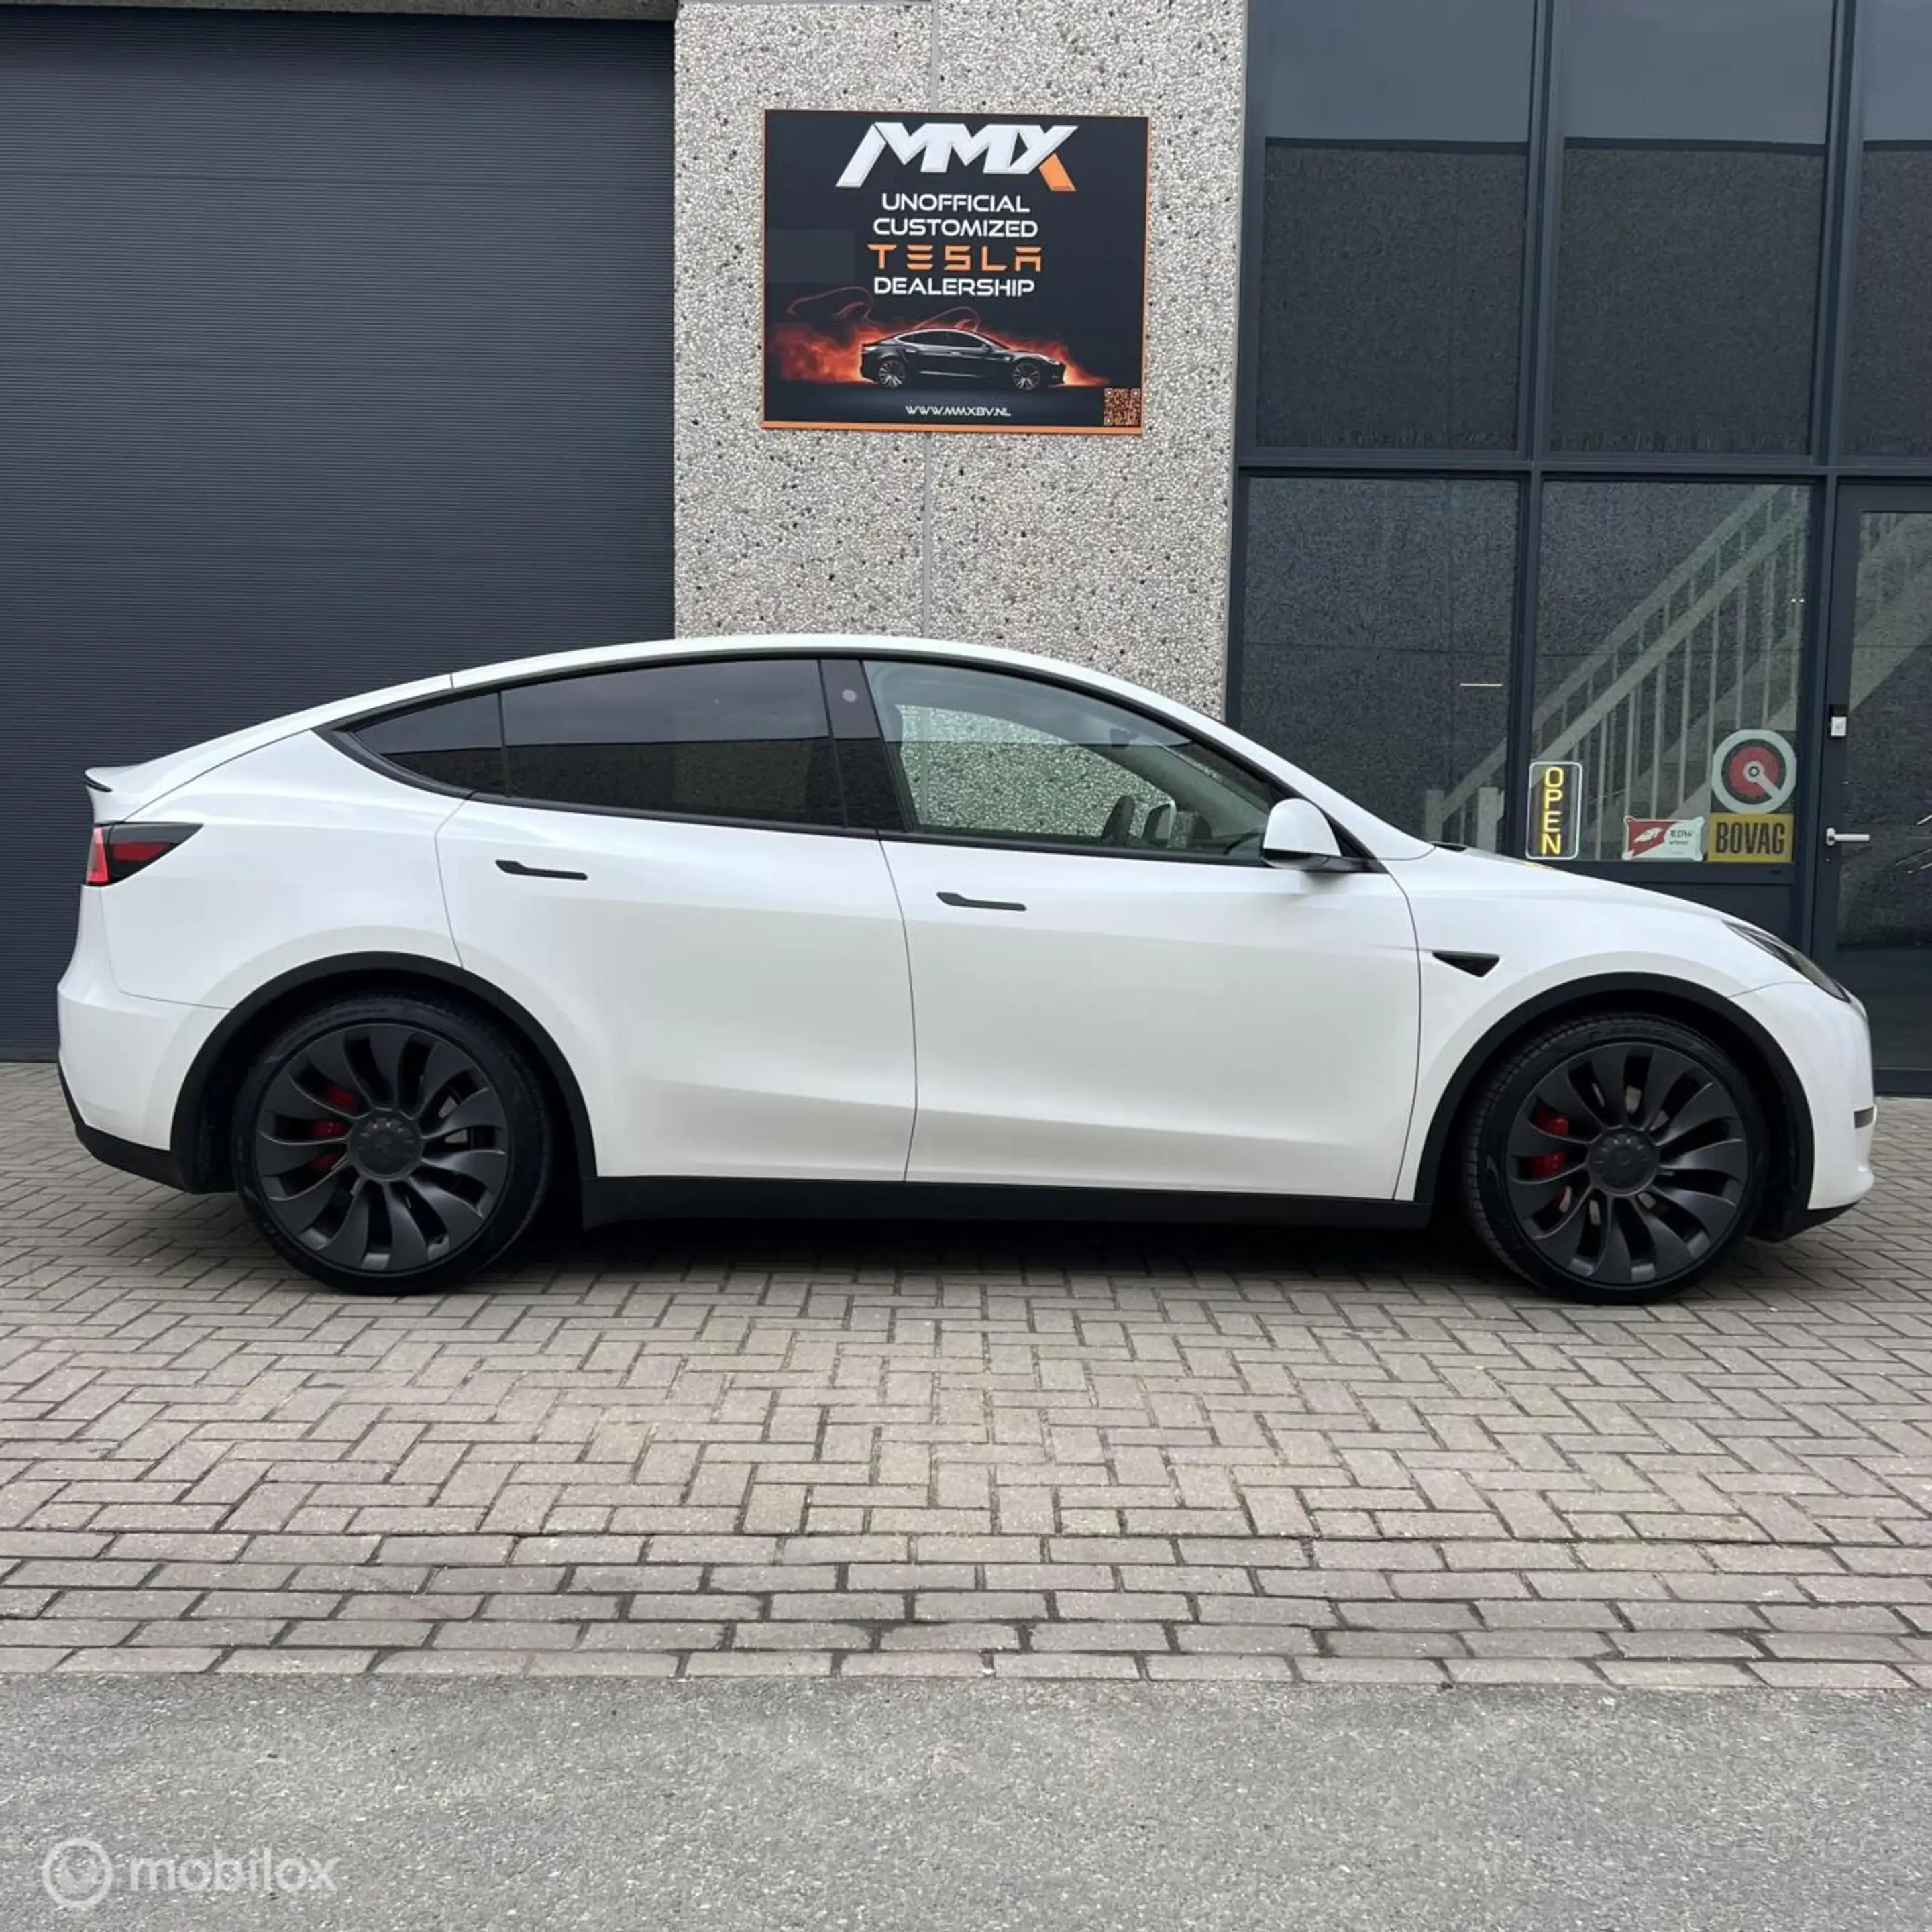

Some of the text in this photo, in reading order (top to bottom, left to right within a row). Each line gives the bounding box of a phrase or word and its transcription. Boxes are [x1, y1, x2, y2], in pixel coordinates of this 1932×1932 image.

[835, 121, 1079, 192] MMX
[881, 193, 1030, 213] UNOFFICIAL
[873, 217, 1038, 237] CUSTOMIZED
[867, 244, 1042, 272] TESLA
[873, 276, 1035, 297] DEALERSHIP
[1542, 766, 1564, 855] OPEN
[1715, 822, 1785, 855] BOVAG
